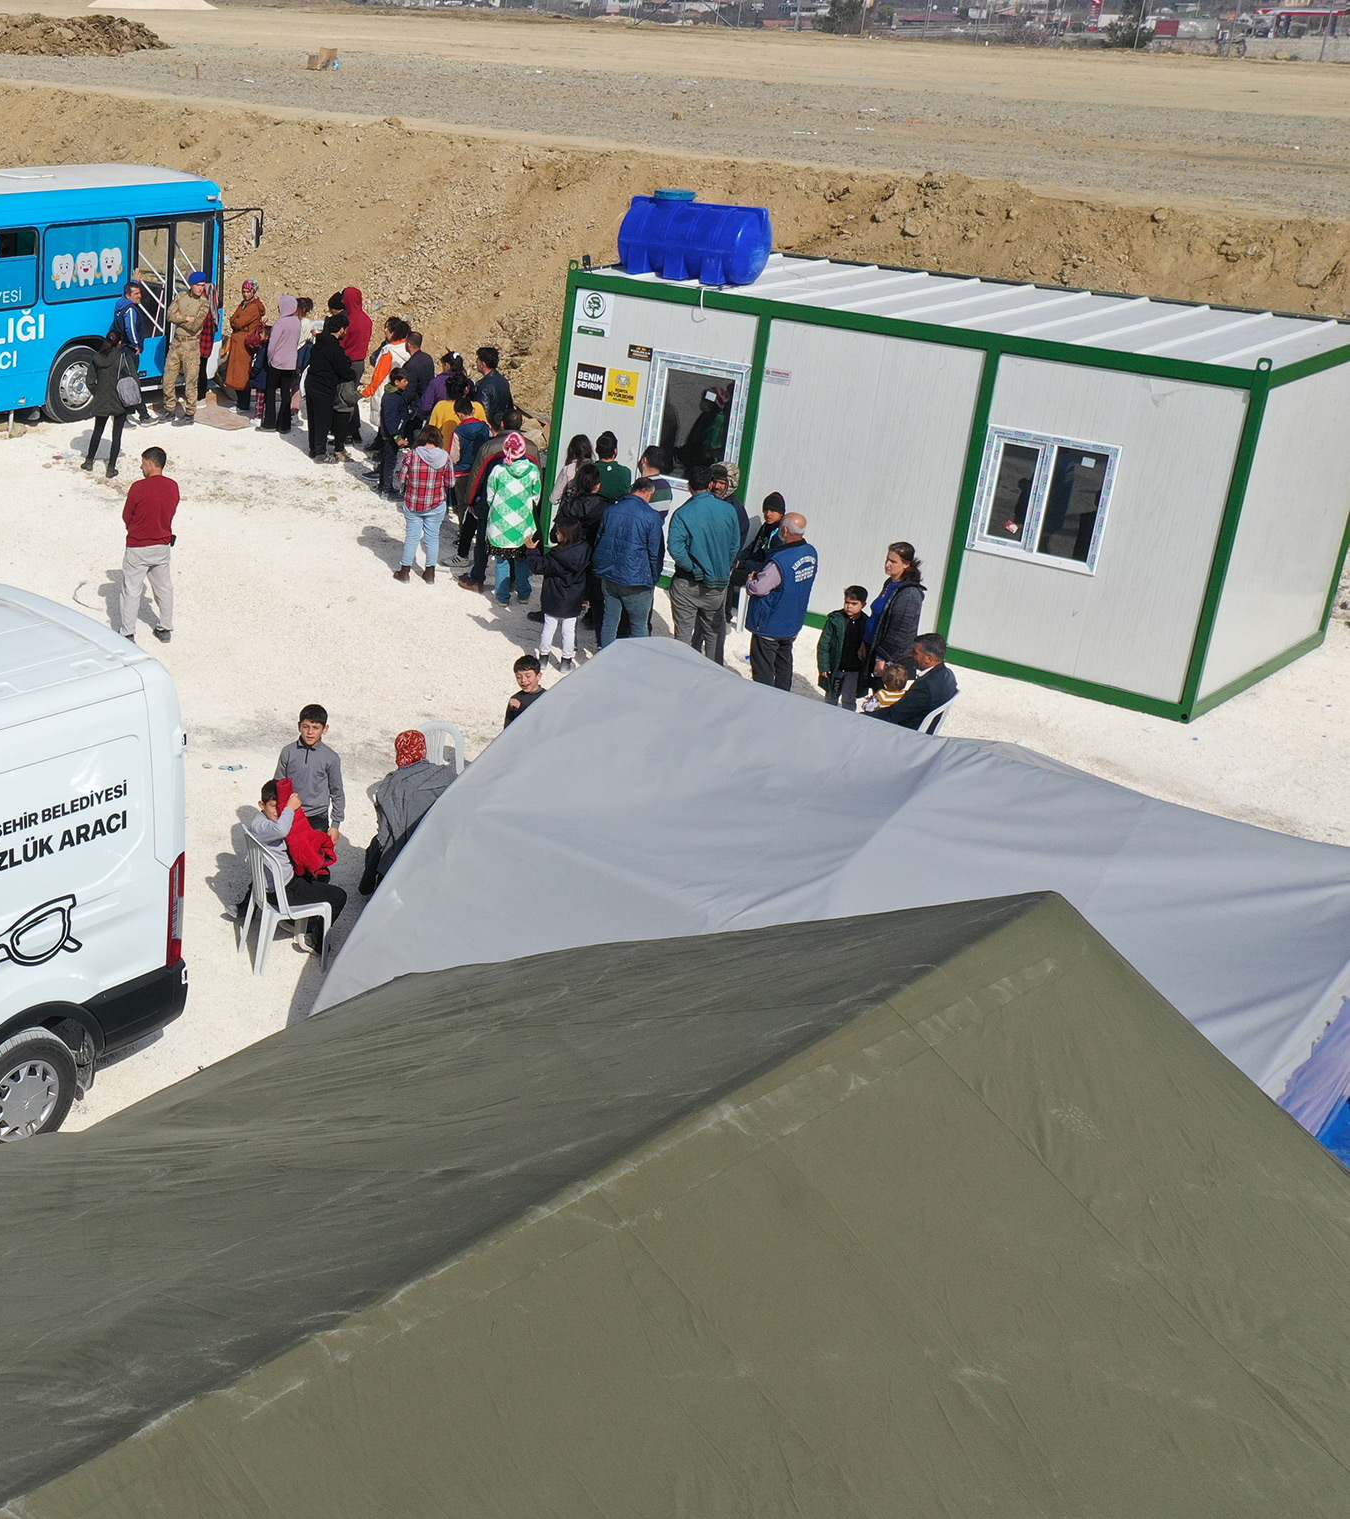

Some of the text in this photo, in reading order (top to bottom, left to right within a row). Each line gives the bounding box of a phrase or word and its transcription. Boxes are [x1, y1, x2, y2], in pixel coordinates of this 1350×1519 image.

[576, 380, 603, 392] ŞEHRİM
[577, 370, 604, 383] BENİM
[41, 779, 128, 824] BELEDİYESİ
[58, 810, 128, 851] ARACI
